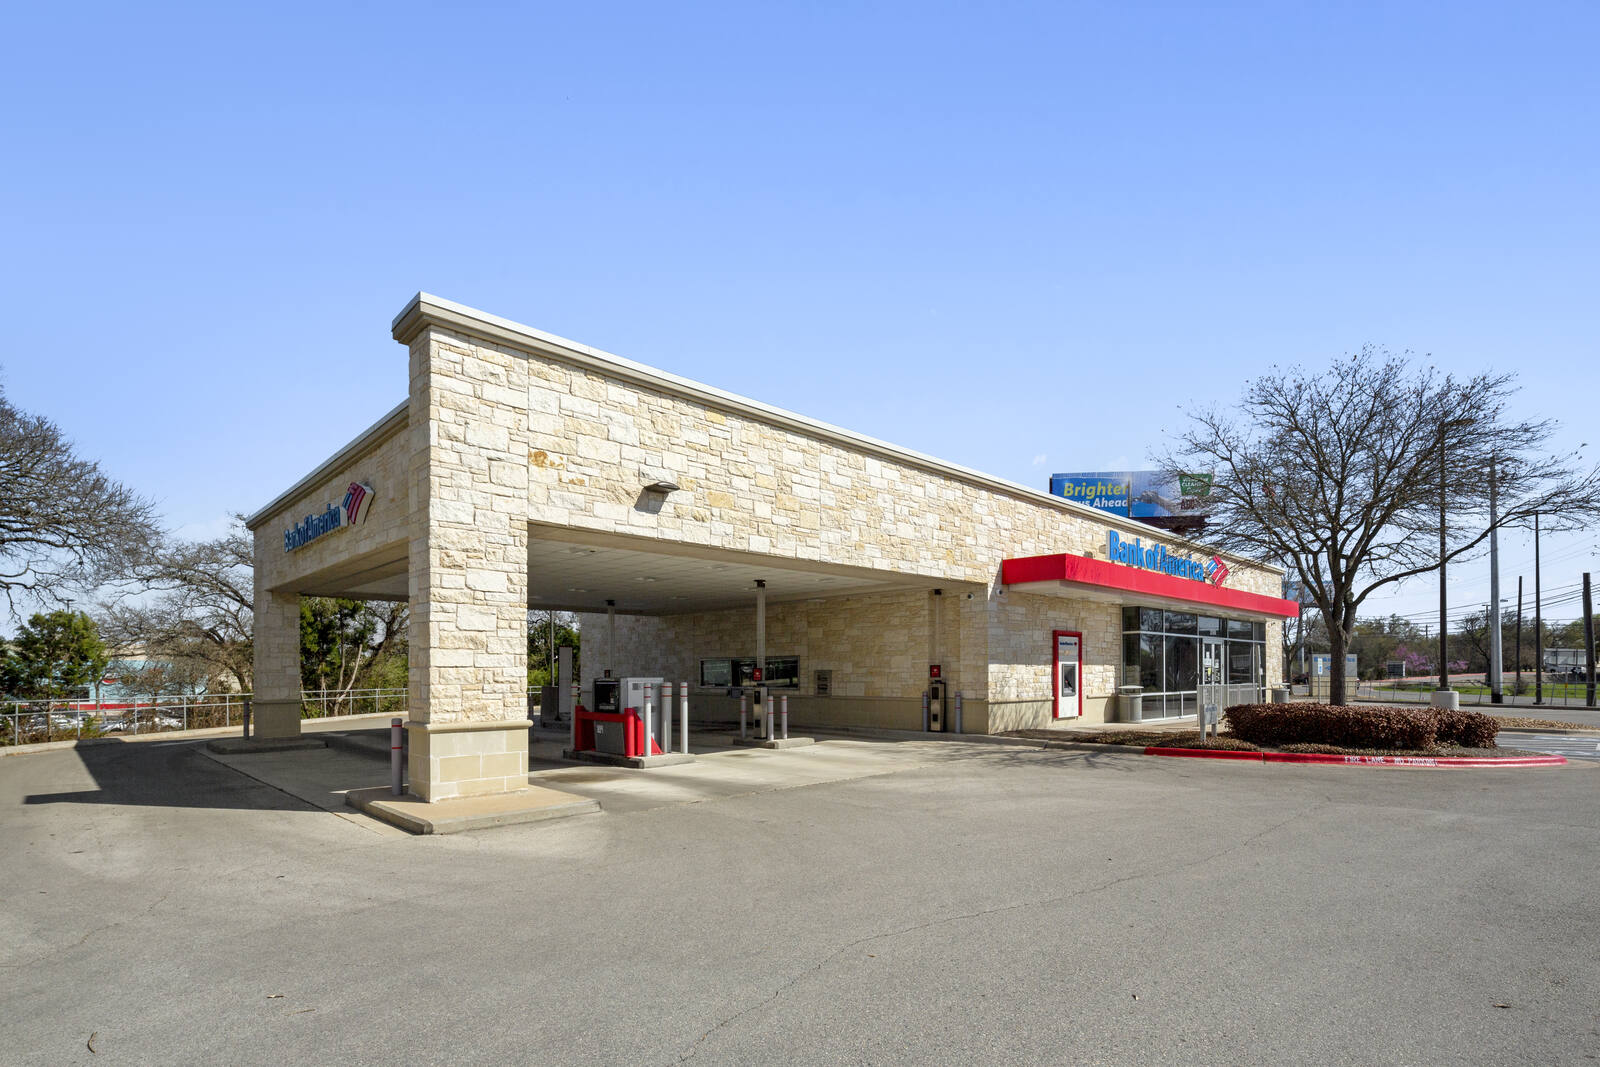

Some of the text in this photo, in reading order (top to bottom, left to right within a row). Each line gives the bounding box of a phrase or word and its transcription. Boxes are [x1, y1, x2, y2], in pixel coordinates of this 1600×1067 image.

[1063, 482, 1129, 499] Brighter
[1092, 497, 1129, 508] Ahead
[285, 522, 300, 553] Bank
[308, 503, 341, 540] America
[1110, 530, 1205, 582] Bank of America
